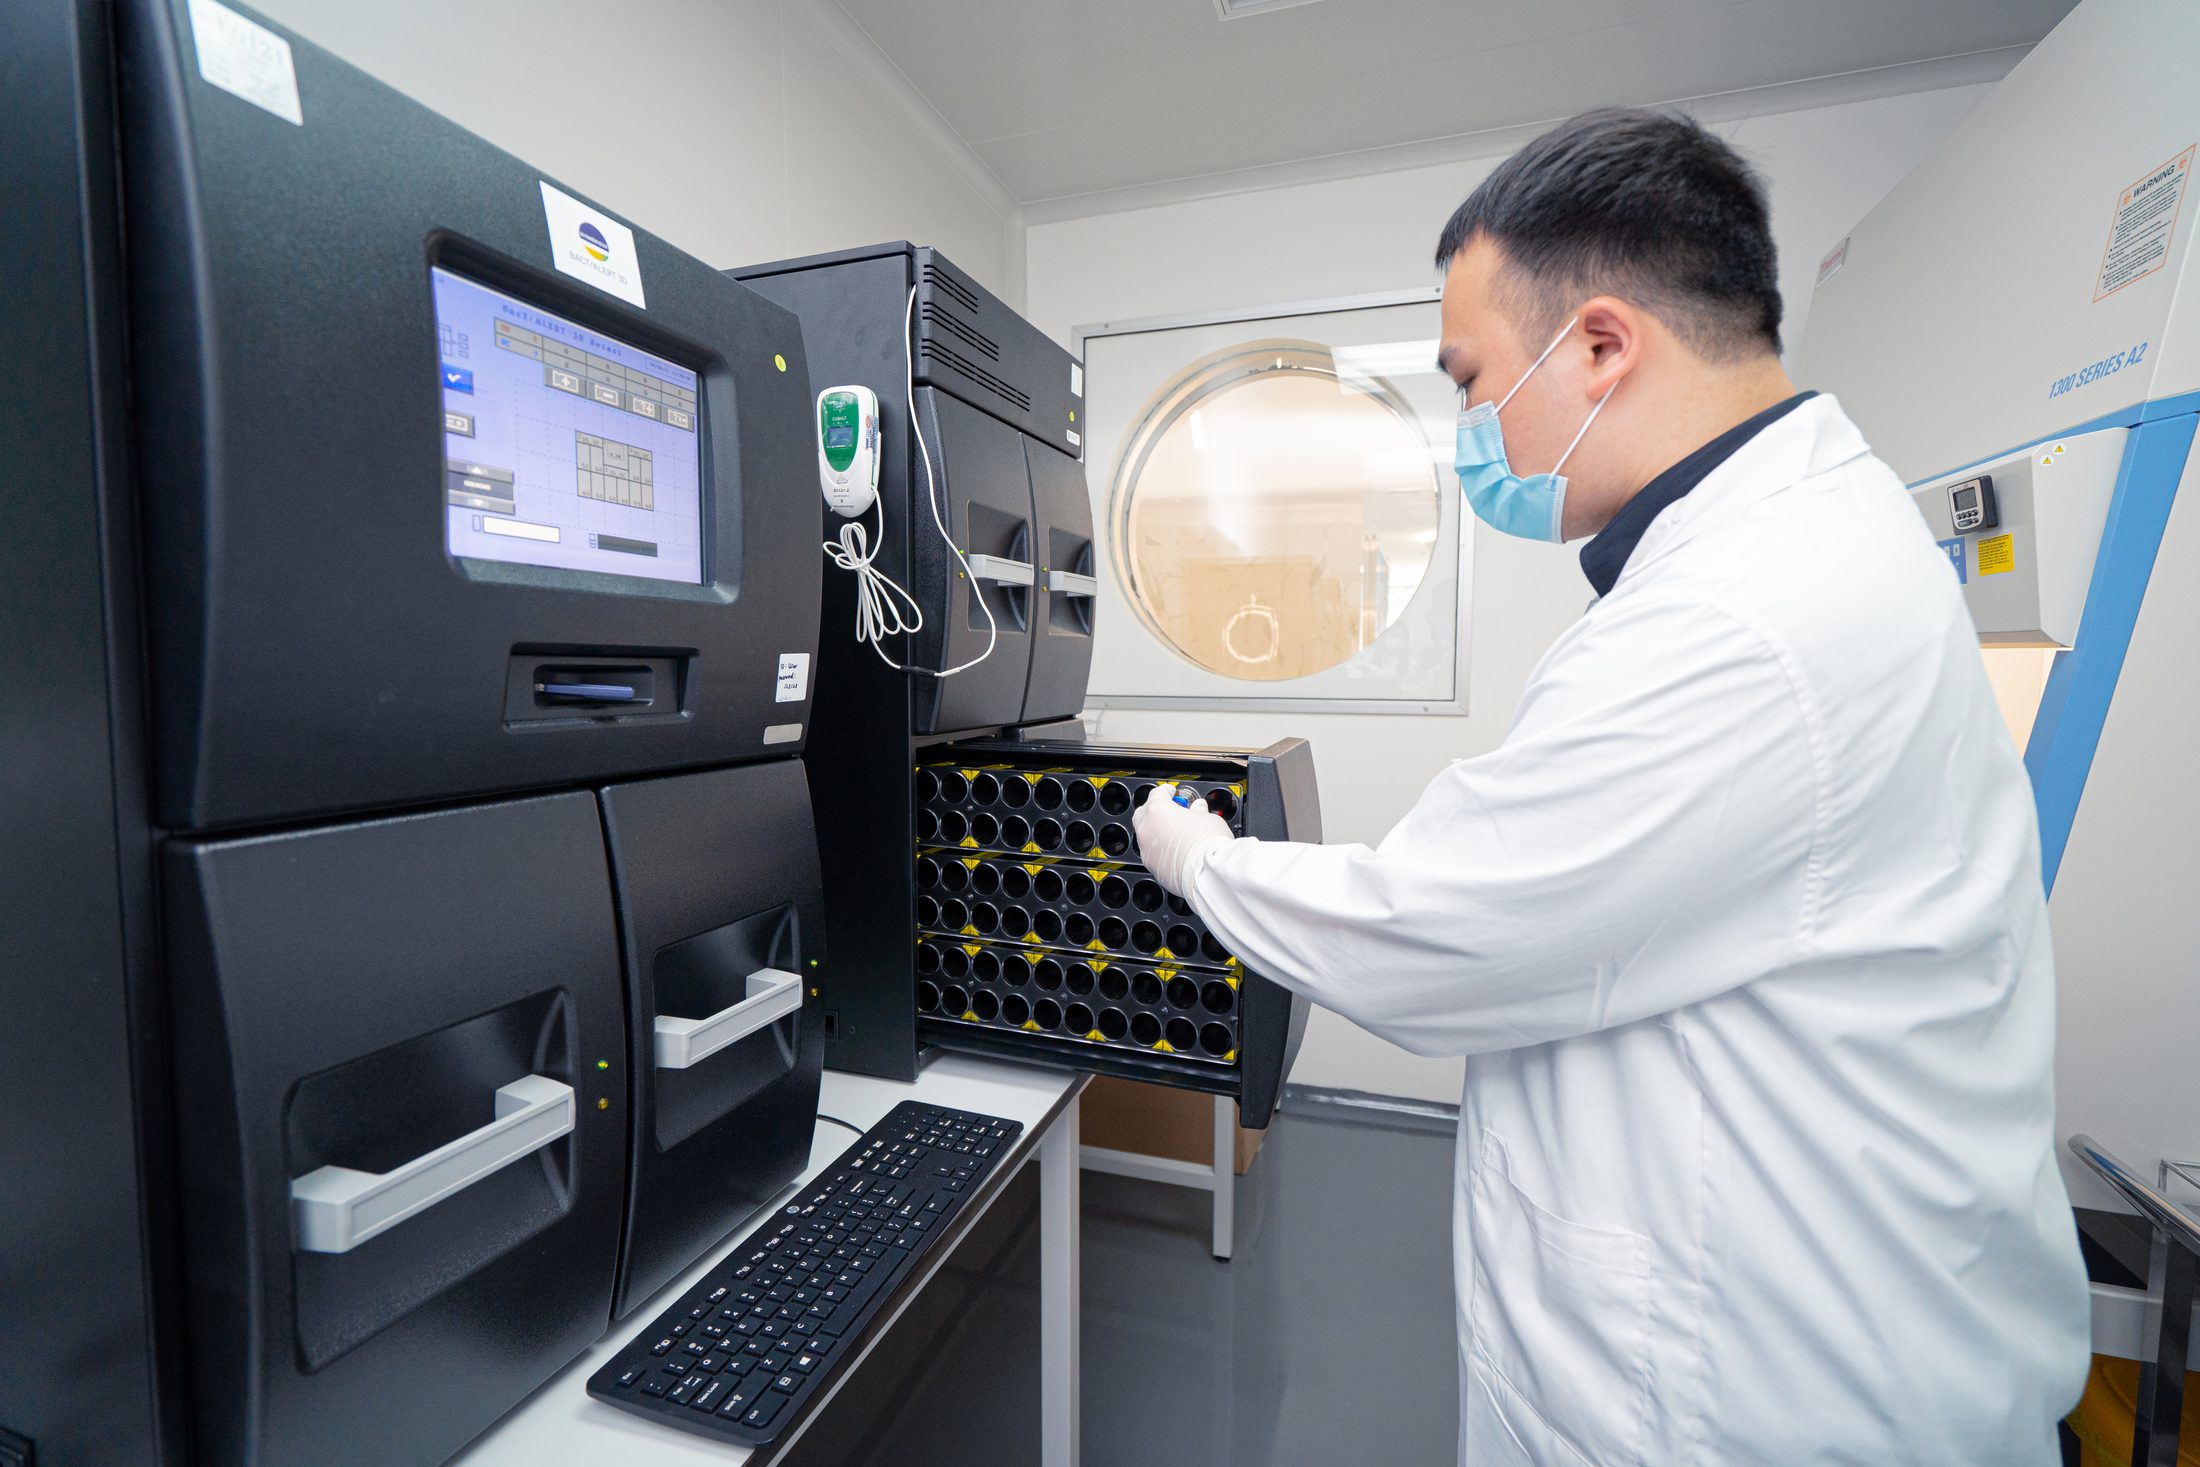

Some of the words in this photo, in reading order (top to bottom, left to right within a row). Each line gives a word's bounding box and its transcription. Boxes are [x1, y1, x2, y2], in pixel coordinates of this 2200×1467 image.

[2133, 165, 2175, 198] WARNING
[2049, 373, 2076, 399] 1300
[2076, 351, 2125, 388] SERIES
[2124, 342, 2148, 368] A2
